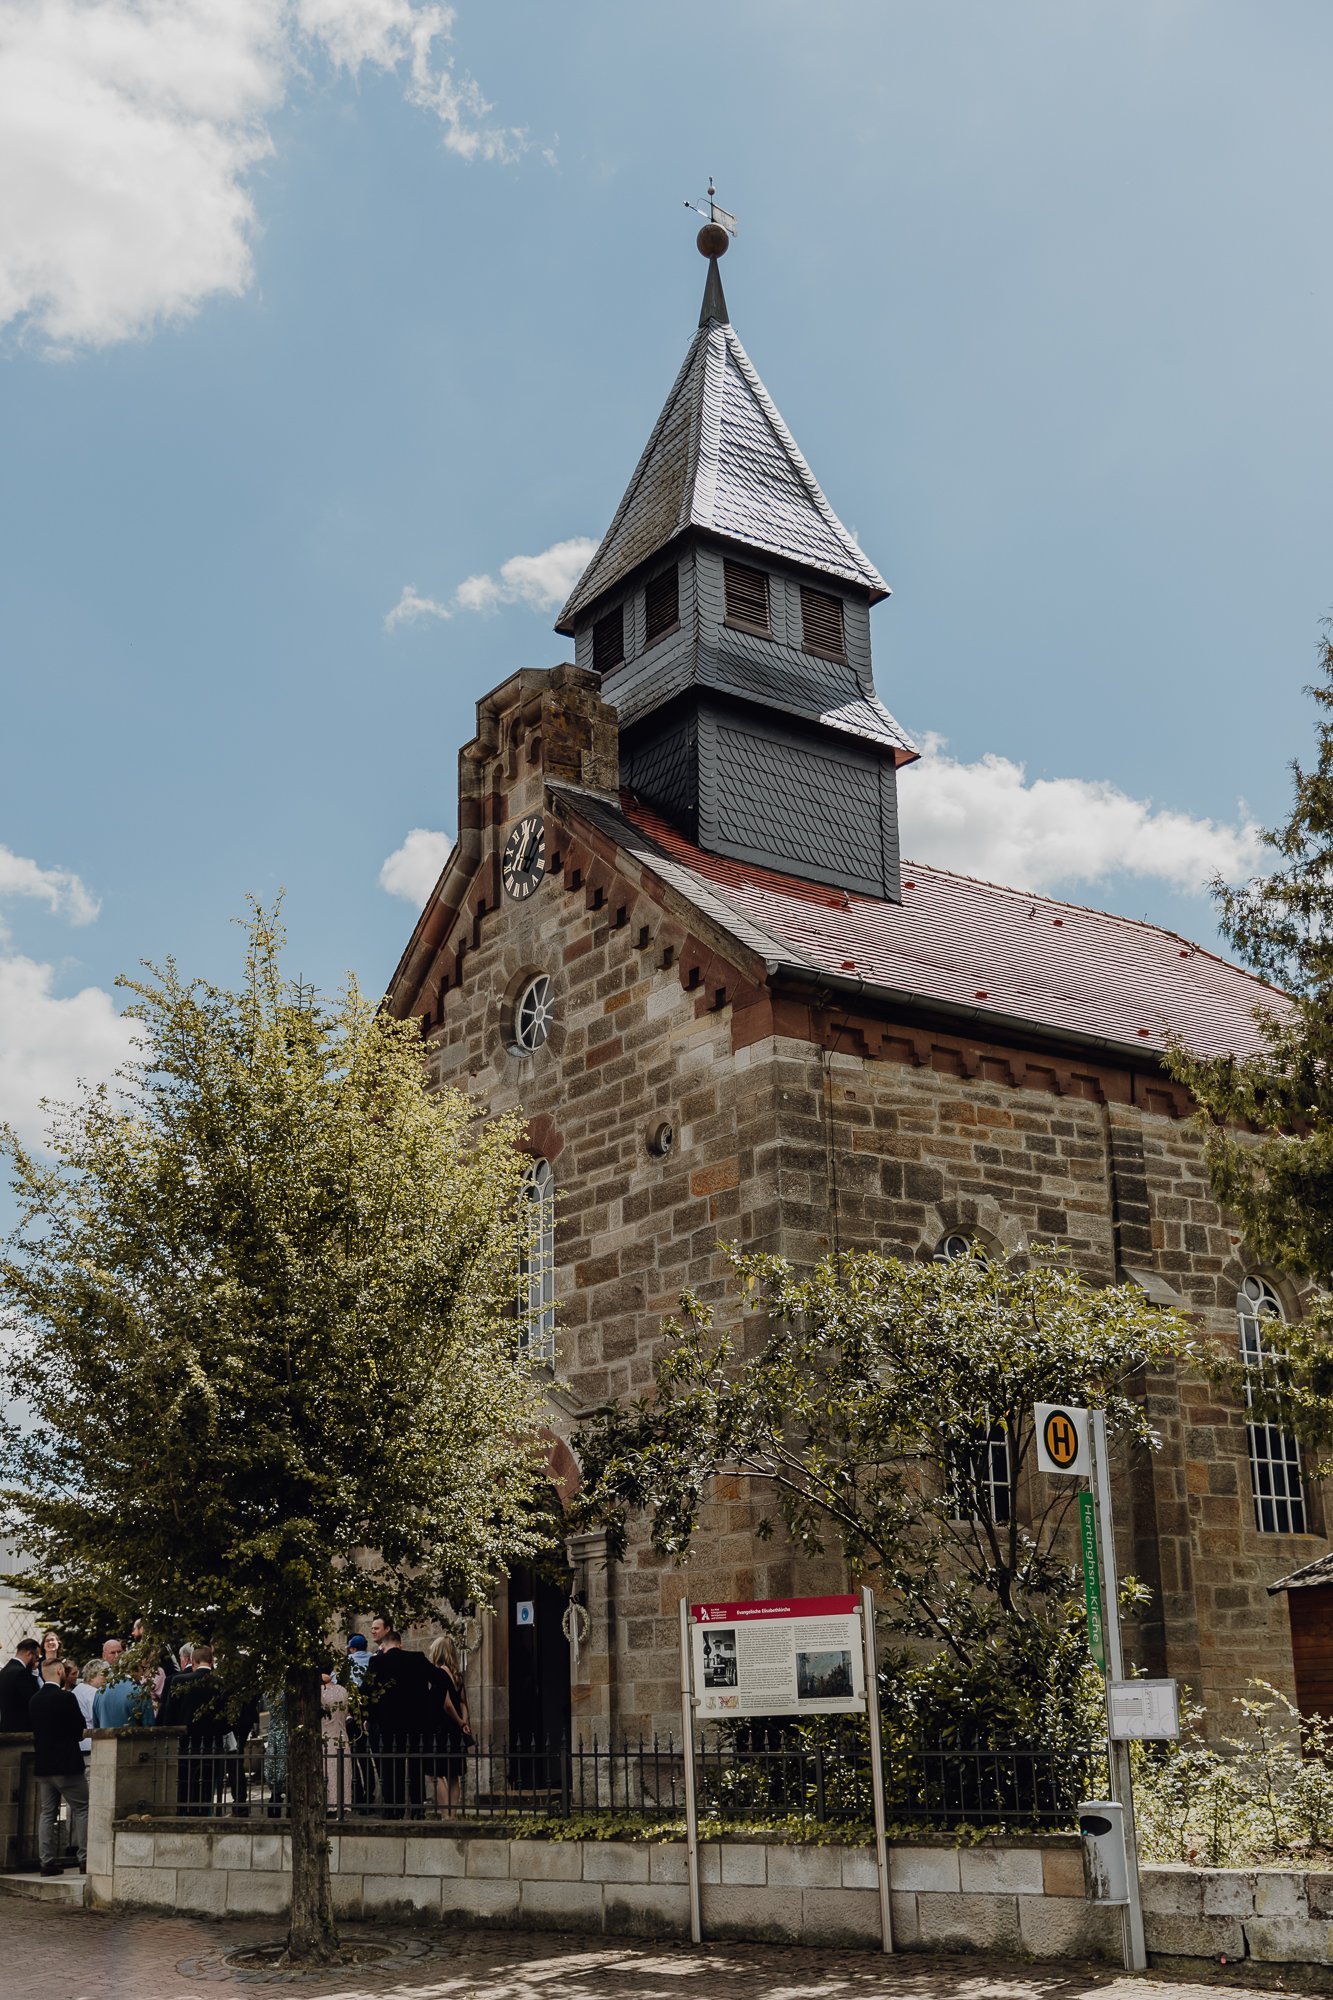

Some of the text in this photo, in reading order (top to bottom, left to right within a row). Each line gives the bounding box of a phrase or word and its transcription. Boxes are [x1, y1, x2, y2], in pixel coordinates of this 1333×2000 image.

[506, 848, 514, 857] X
[1052, 1422, 1070, 1457] H
[1083, 1503, 1100, 1644] Hertinghsn.-Kirche
